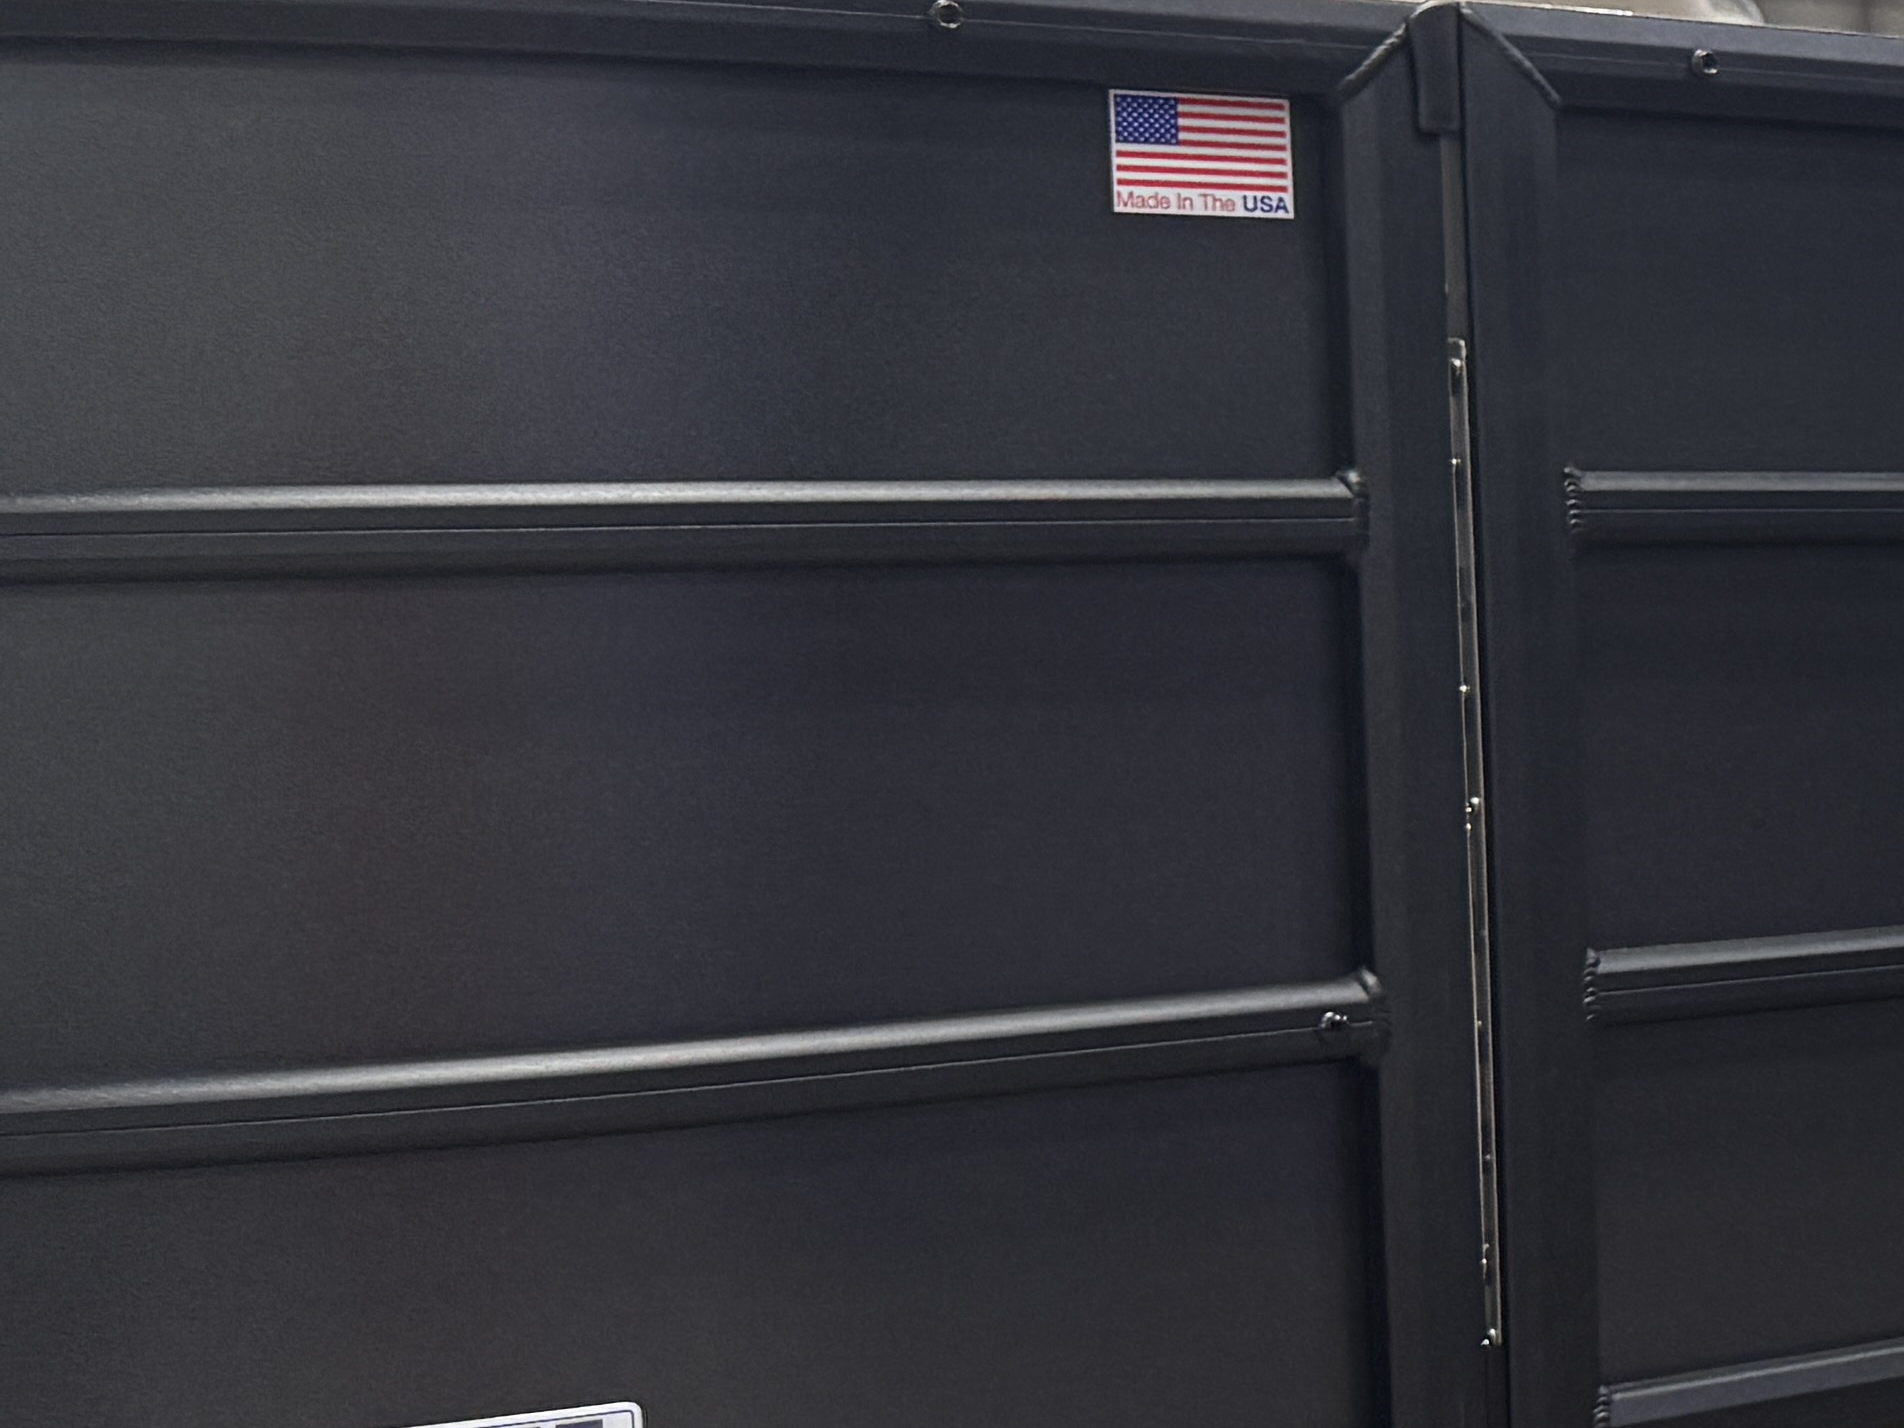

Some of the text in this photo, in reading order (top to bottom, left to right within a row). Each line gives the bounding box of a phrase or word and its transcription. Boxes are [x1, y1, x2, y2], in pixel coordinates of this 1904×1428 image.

[1116, 190, 1290, 214] Made In The USA
